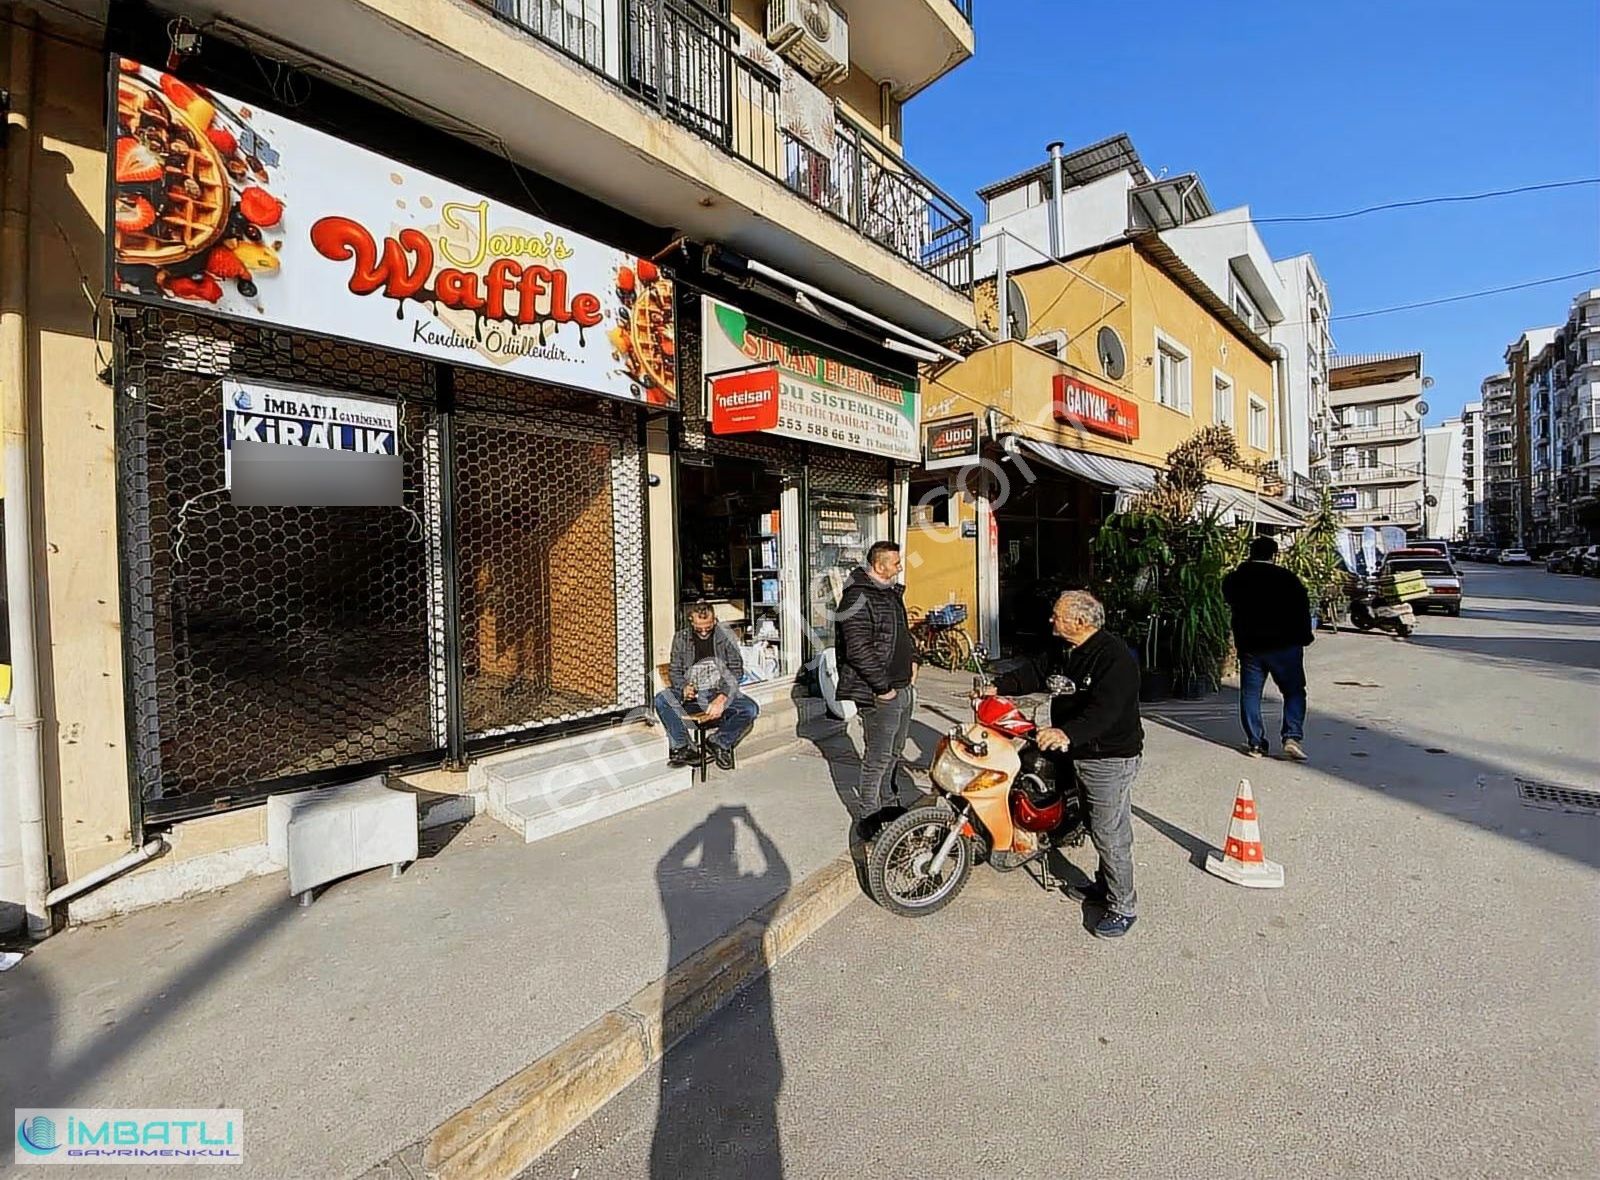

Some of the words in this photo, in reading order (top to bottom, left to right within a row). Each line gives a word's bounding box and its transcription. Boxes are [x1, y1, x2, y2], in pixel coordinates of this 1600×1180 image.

[440, 200, 574, 268] Java's
[310, 216, 603, 328] Waffle
[413, 319, 477, 350] Kendini
[485, 326, 585, 364] Ödüllendir...
[741, 327, 819, 379] SİNAN
[717, 387, 773, 408] netelsan
[810, 390, 899, 426] SİSTEMLERİ
[807, 422, 829, 437] 588
[831, 427, 845, 441] 66
[847, 432, 861, 444] 32
